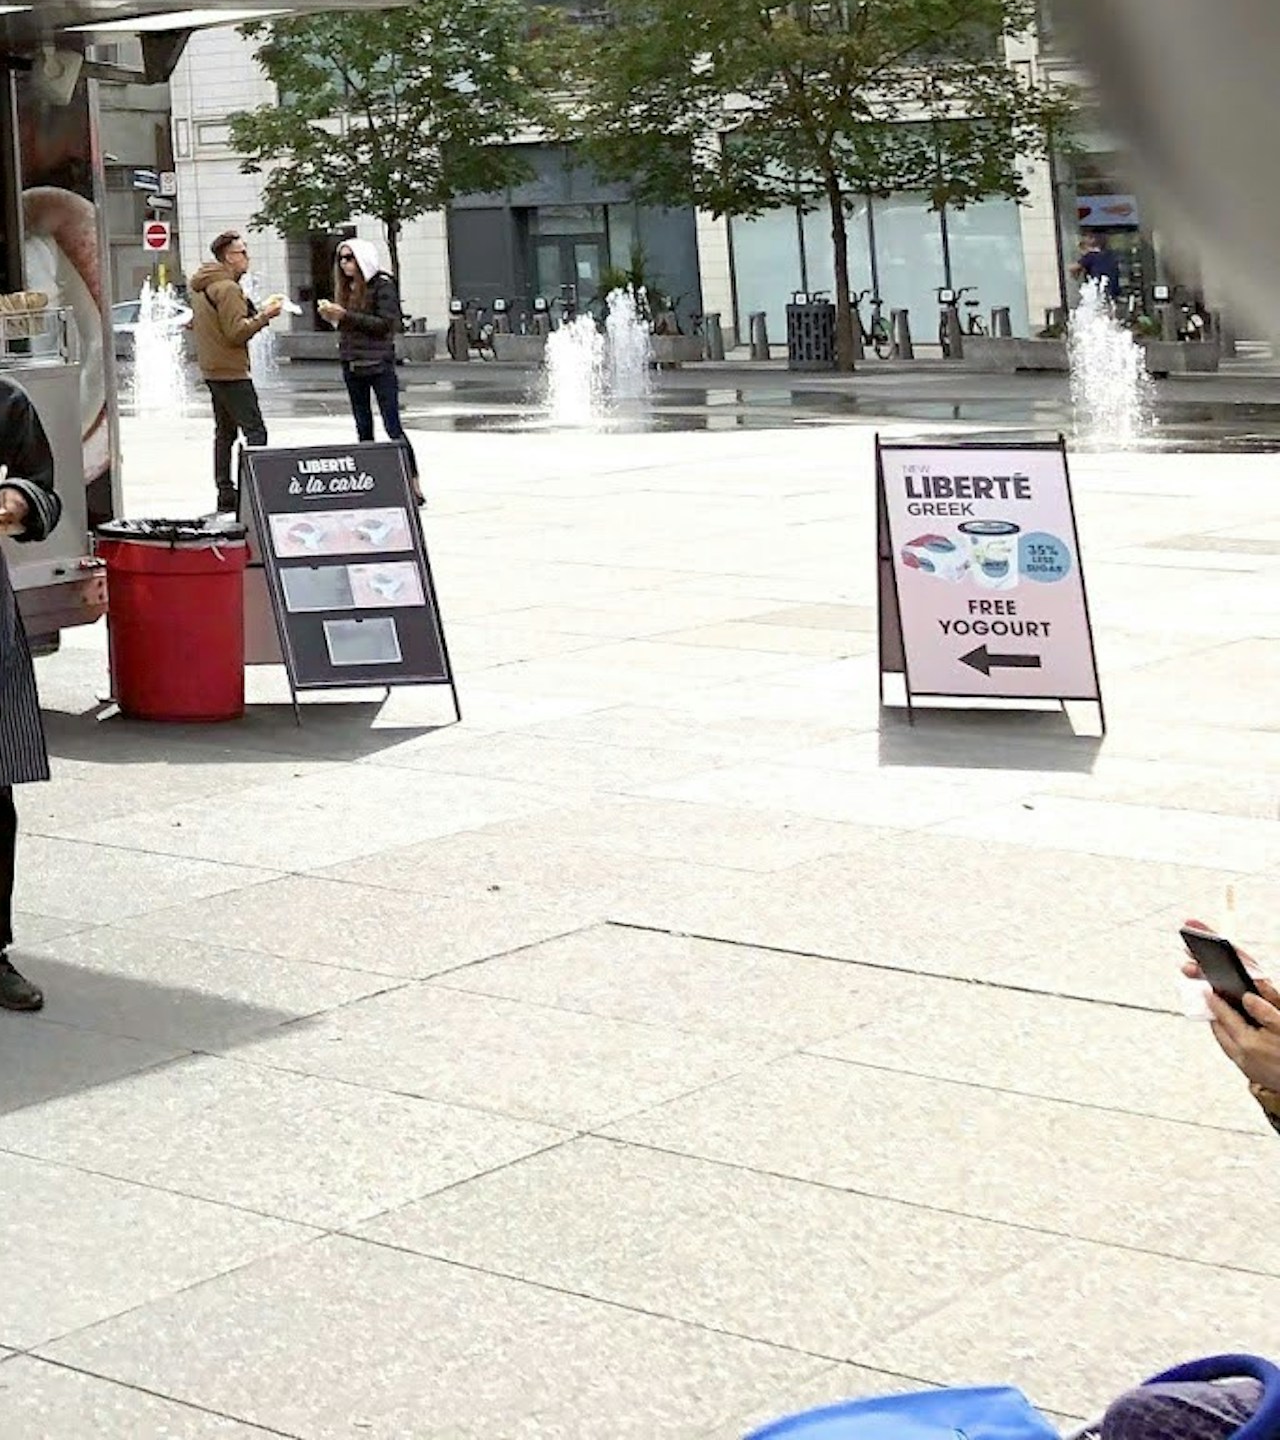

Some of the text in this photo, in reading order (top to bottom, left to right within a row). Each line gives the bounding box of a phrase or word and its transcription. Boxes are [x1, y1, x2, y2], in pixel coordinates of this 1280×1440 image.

[297, 455, 357, 474] LIBERTÉ
[305, 474, 326, 494] la
[329, 472, 375, 492] carte
[904, 472, 1032, 500] LIBERTÉ
[906, 502, 976, 517] GREEK
[968, 600, 1018, 616] FREE
[938, 620, 1052, 637] YOGOURT
